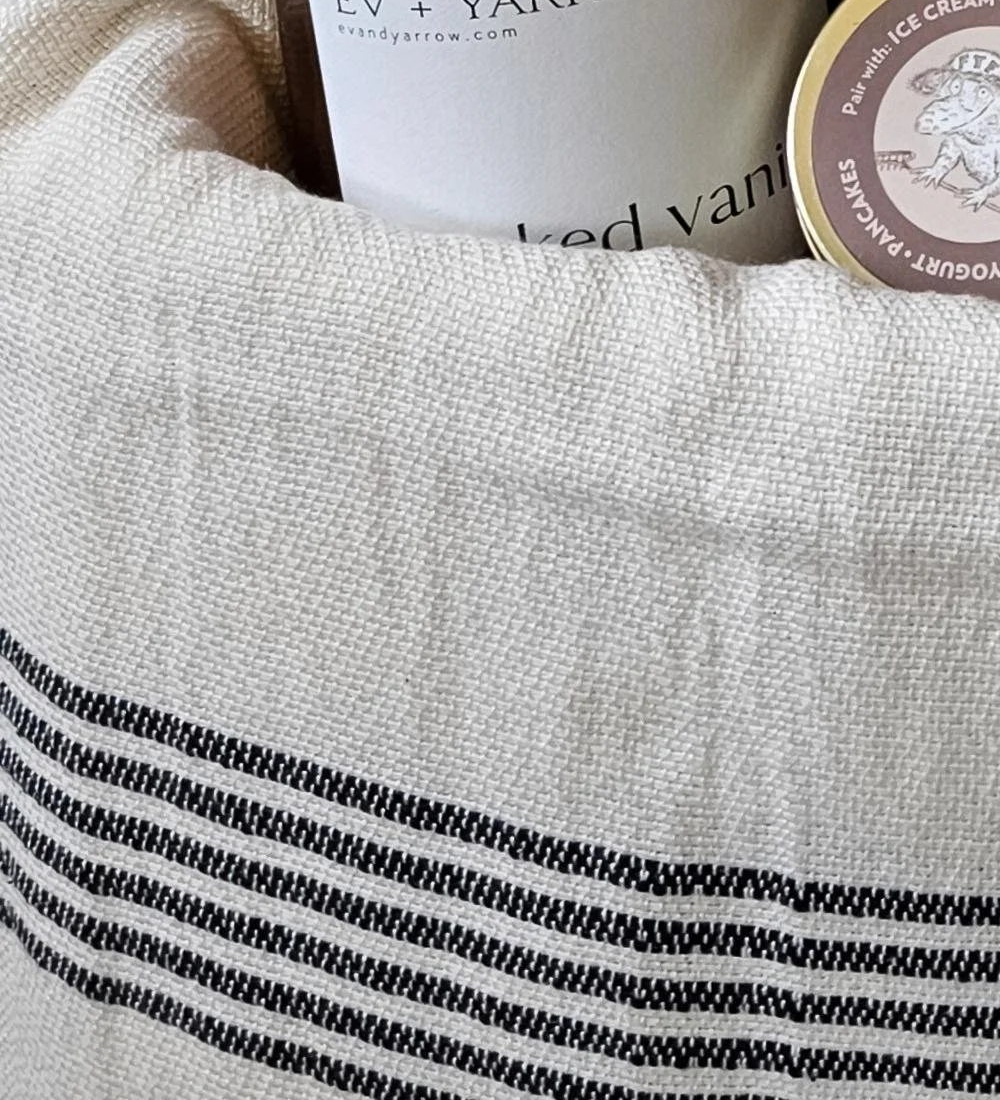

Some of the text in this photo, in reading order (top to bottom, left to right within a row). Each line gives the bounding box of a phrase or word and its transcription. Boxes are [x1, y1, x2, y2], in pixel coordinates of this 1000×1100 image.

[410, 0, 433, 19] +
[338, 23, 518, 46] evandyarrow.com
[887, 13, 923, 45] ICE
[861, 43, 894, 80] with:
[841, 81, 867, 117] Pair
[666, 142, 788, 237] vani
[838, 158, 904, 258] PANCAKES
